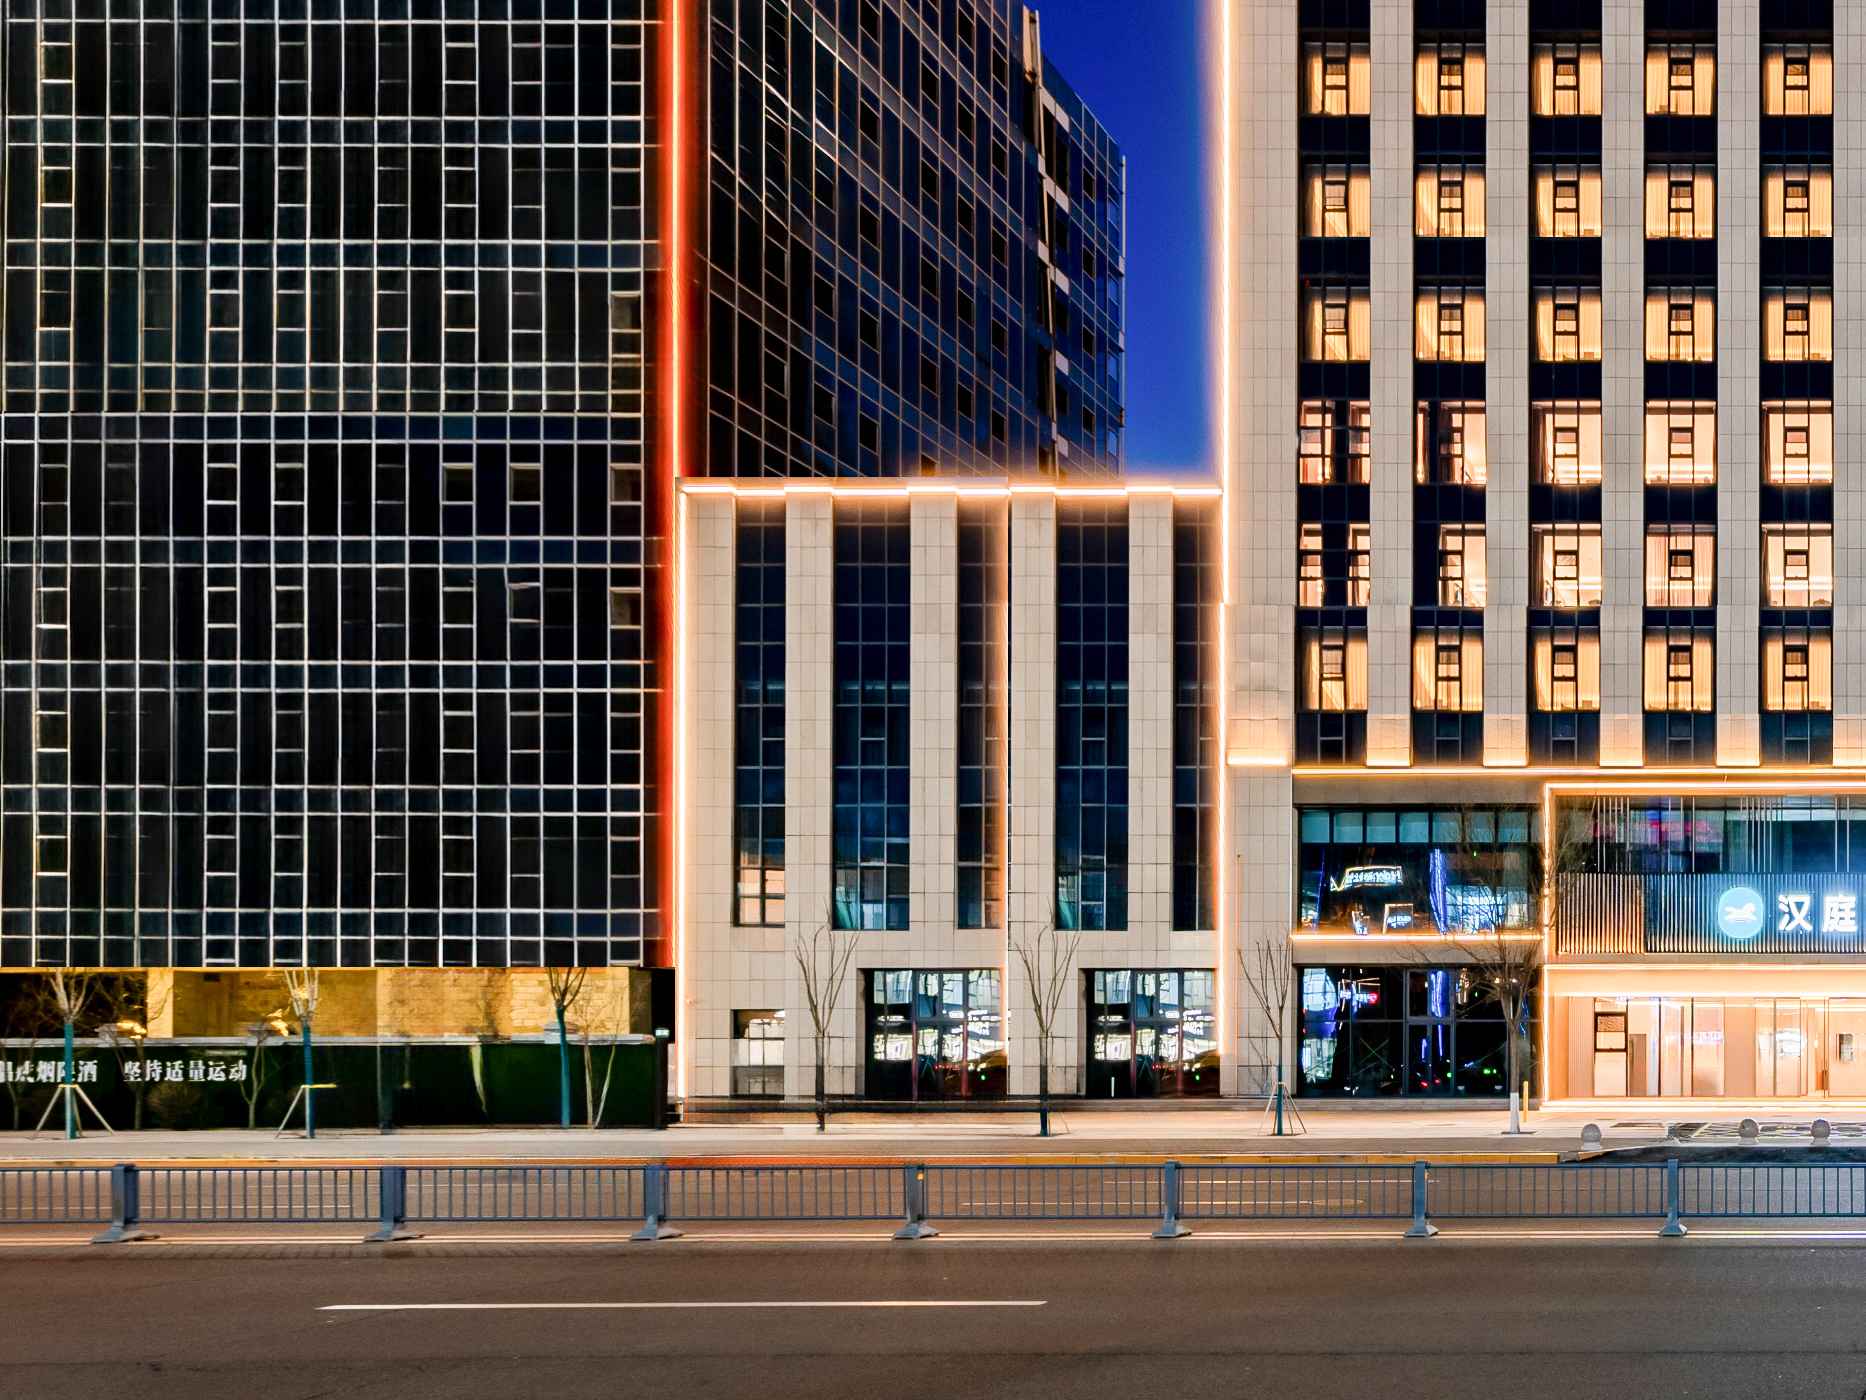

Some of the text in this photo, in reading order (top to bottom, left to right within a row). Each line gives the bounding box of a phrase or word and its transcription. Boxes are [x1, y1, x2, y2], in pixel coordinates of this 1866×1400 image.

[123, 1060, 248, 1082] 坚持适量运动
